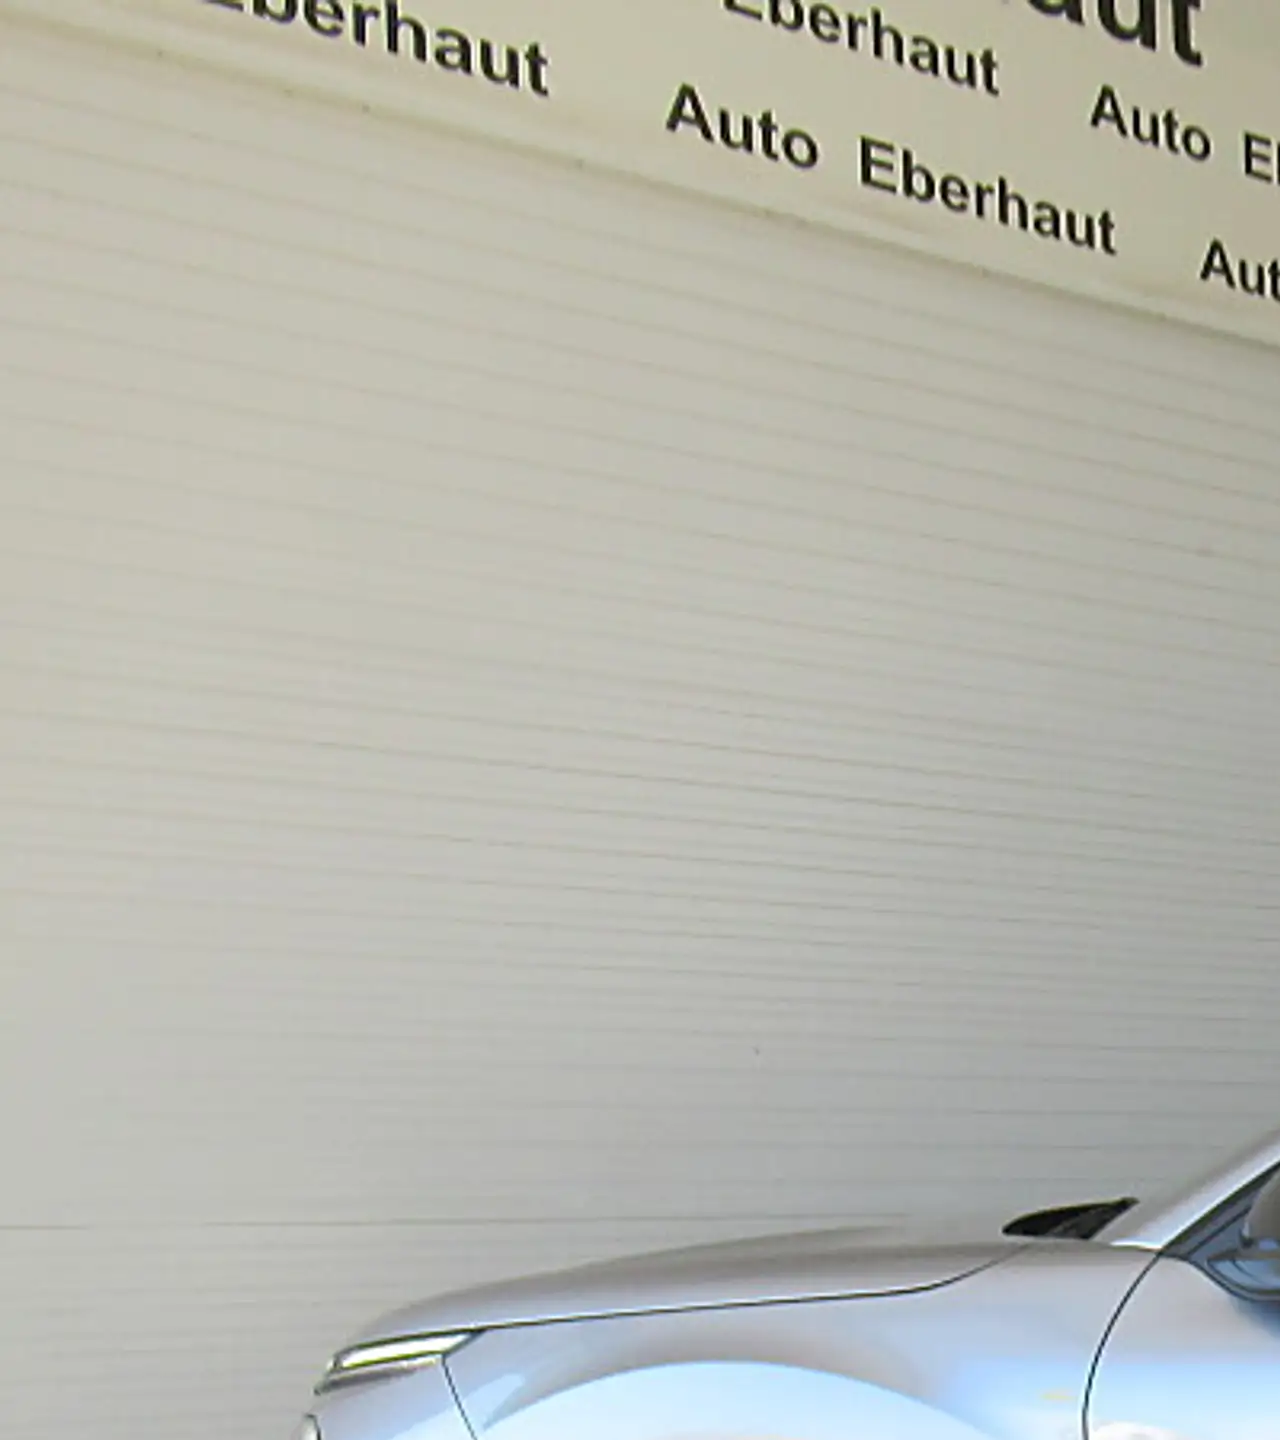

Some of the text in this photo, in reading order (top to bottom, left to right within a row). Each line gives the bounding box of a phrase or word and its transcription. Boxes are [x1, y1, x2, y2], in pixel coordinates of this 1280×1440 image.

[206, 0, 548, 98] erhaut
[665, 82, 1117, 257] Auto Eberhaut
[1090, 84, 1211, 163] Auto
